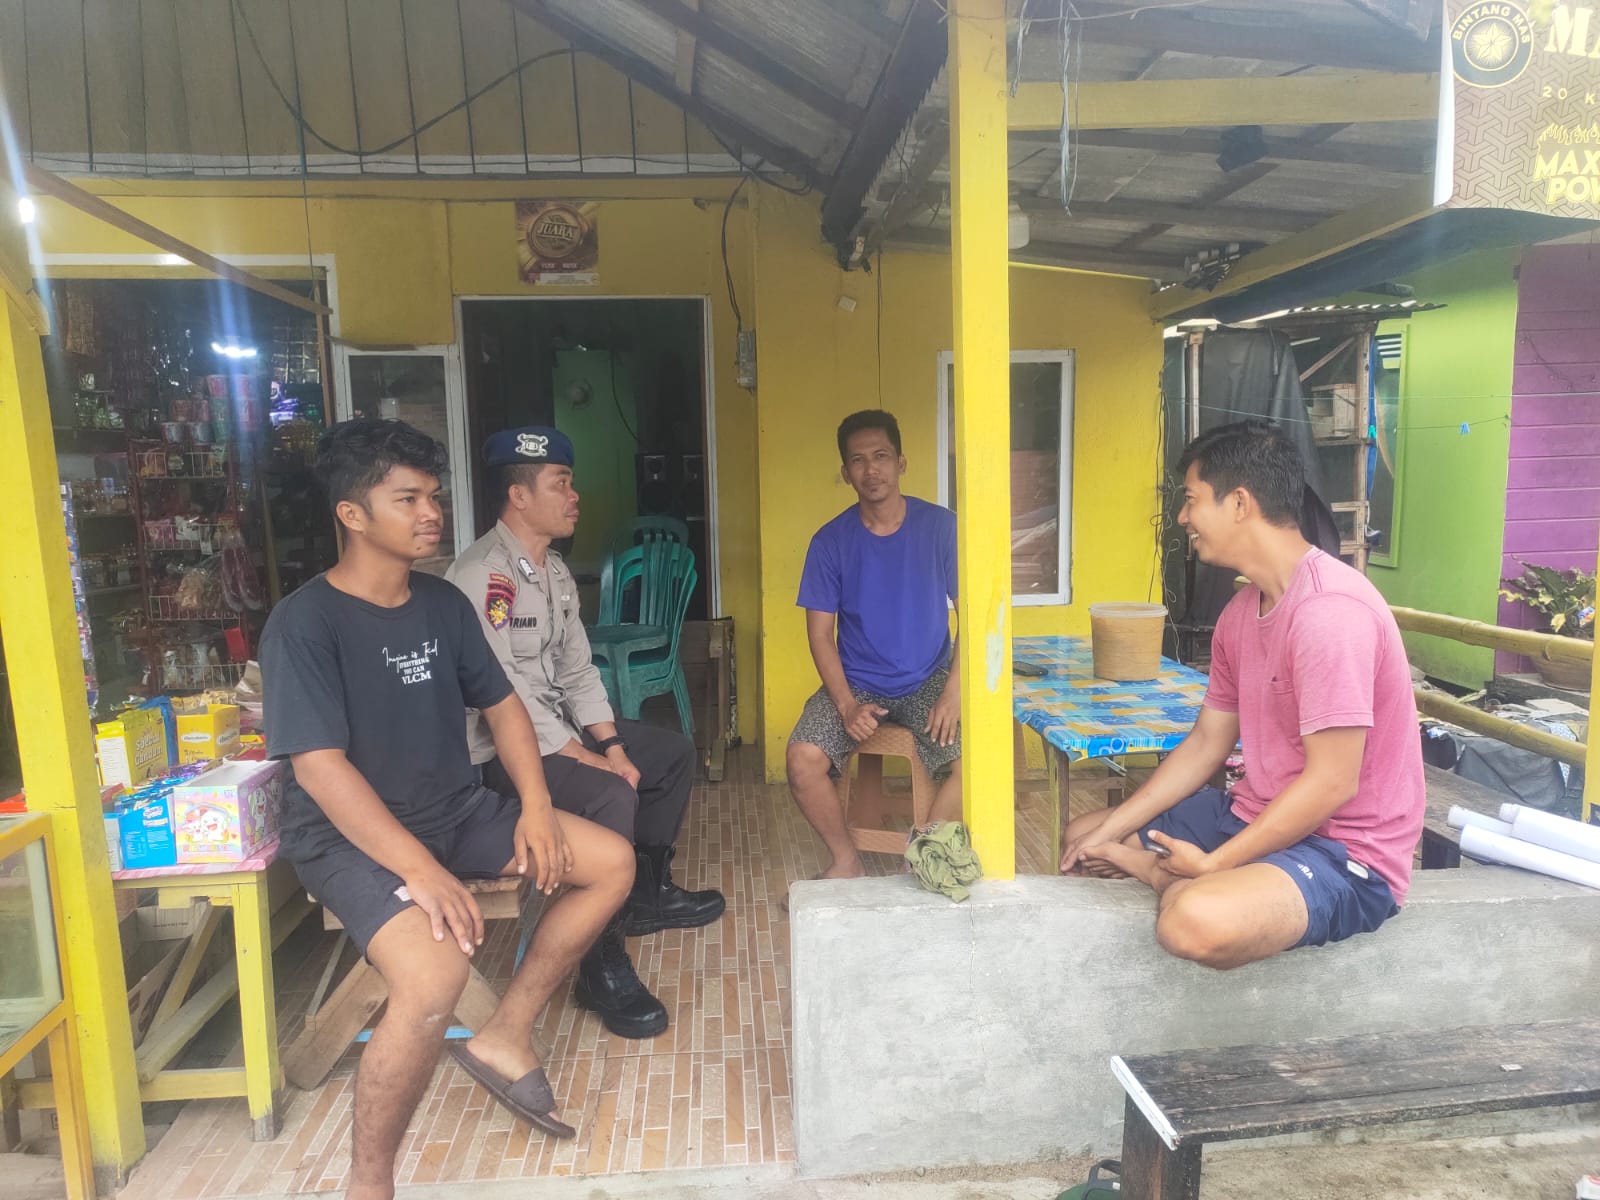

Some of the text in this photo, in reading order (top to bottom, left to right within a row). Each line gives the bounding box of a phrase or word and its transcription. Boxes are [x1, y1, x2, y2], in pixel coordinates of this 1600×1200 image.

[1452, 5, 1531, 44] BINTANG MAS
[1533, 149, 1600, 181] MAX
[537, 222, 573, 238] JUARA
[413, 664, 425, 673] CAN
[401, 670, 432, 685] VLCM
